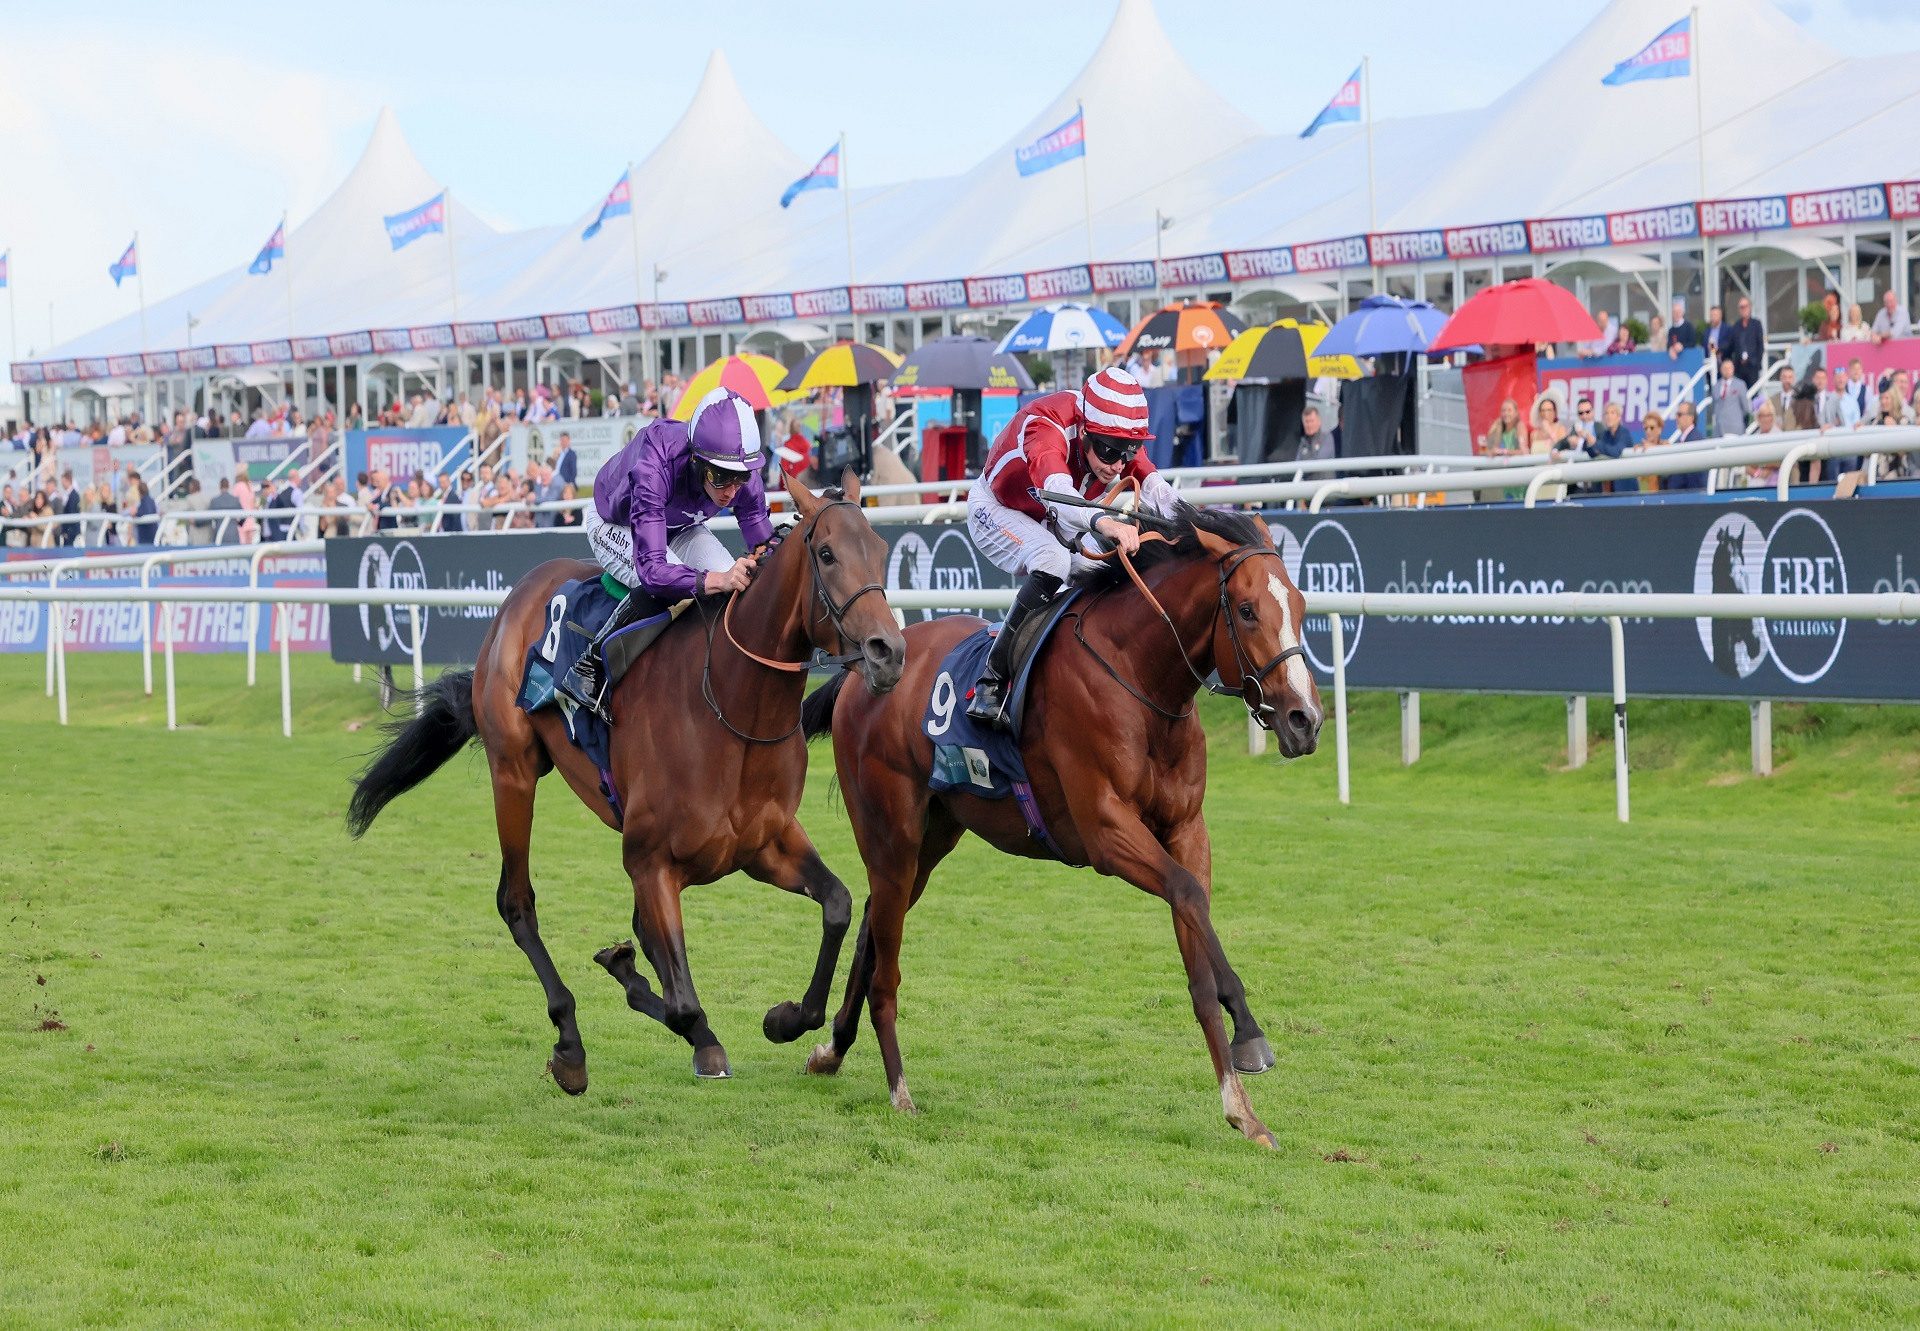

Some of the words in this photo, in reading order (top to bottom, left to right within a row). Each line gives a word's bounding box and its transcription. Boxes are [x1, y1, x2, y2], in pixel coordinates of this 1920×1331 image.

[1702, 196, 1787, 233] BETFRED
[1792, 185, 1886, 226] BETFRED
[1448, 222, 1526, 256] BETFRED
[1530, 217, 1607, 249] BETFRED
[1611, 205, 1696, 243] BETFRED
[1229, 248, 1292, 277] BETFRED
[1297, 238, 1367, 268] BETFRED
[1371, 231, 1444, 264] BETFRED
[1028, 266, 1091, 298] BETFRED
[1093, 262, 1151, 290] BETFRED
[1160, 253, 1225, 285] BETFRED
[852, 286, 904, 312] BETFRED
[908, 281, 965, 309] BETFRED
[968, 276, 1023, 306] BETFRED
[370, 441, 443, 479] BETFRED
[605, 526, 631, 553] Ashby
[541, 594, 567, 663] 8
[1306, 618, 1356, 632] STALLNS
[1772, 620, 1836, 636] STALLIONS
[927, 671, 957, 736] 9
